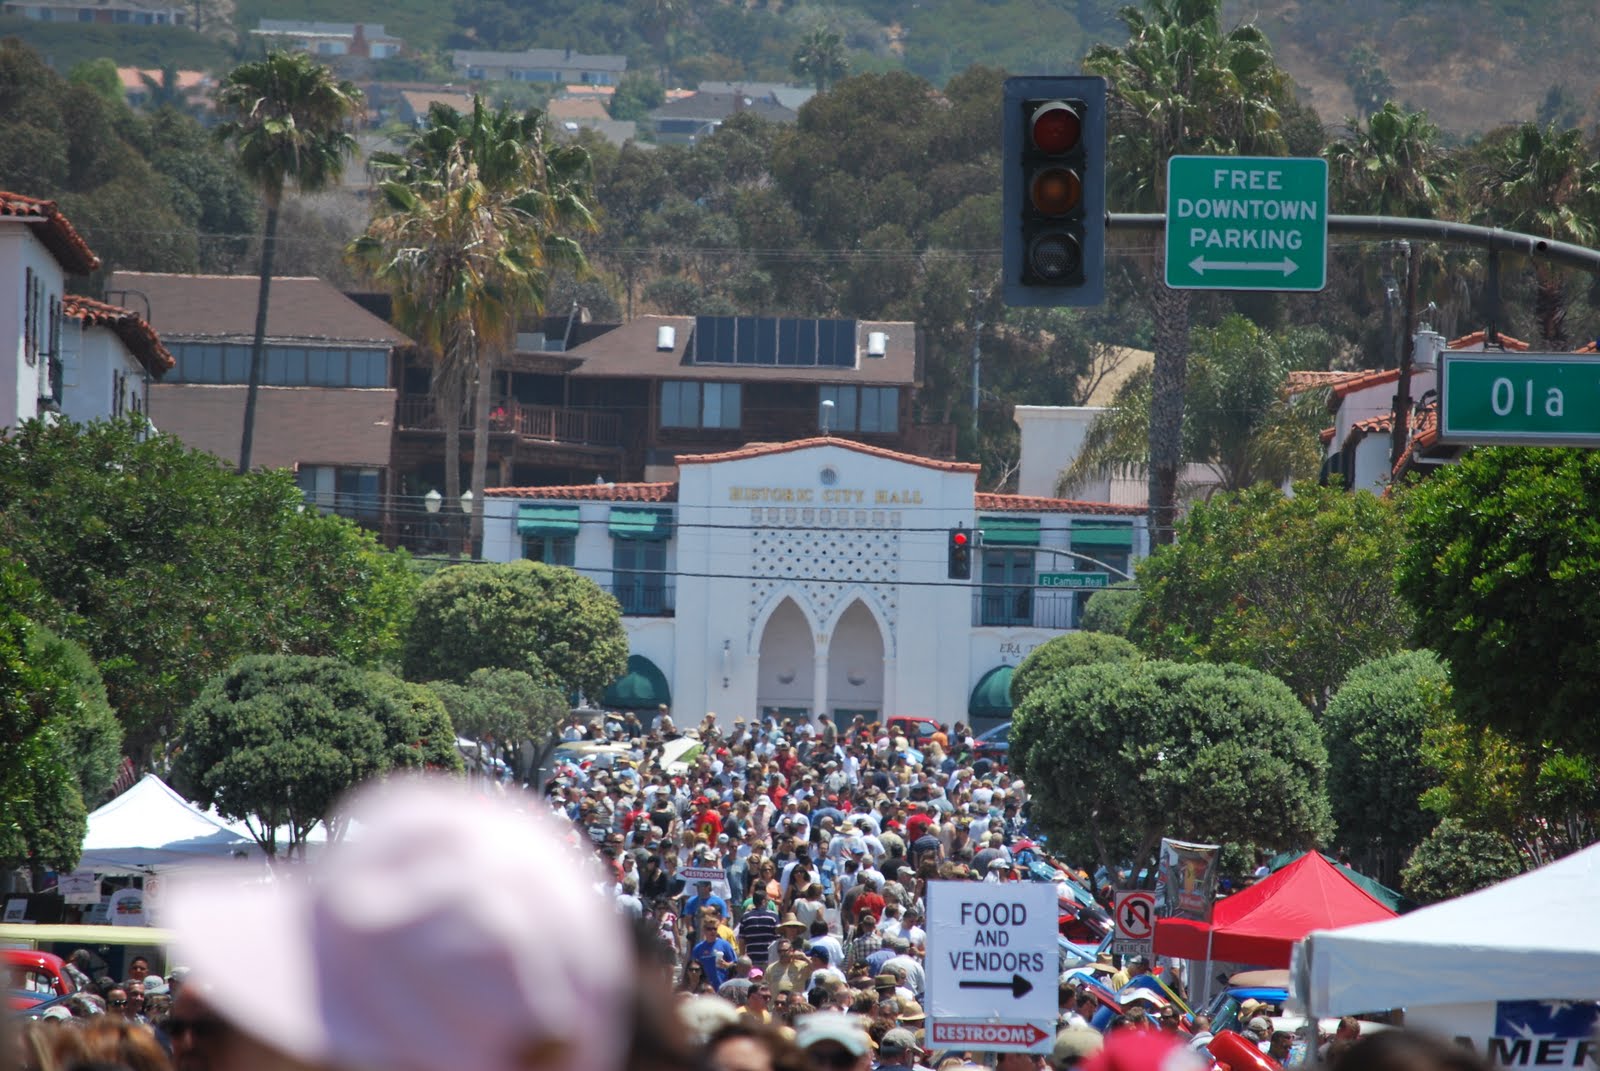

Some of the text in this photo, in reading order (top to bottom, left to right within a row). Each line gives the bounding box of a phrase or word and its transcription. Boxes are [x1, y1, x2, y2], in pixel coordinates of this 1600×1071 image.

[1214, 169, 1283, 190] FREE
[1177, 198, 1317, 220] DOWNTOWN
[1190, 227, 1302, 250] PARKING
[1491, 377, 1564, 417] Ola
[728, 486, 924, 504] HISTORIC CITY HALL
[1043, 576, 1051, 585] El
[1085, 577, 1103, 586] Real
[1000, 643, 1021, 657] ERA
[684, 870, 724, 879] RESTROOMS
[960, 902, 1027, 926] FOOD
[974, 930, 1010, 947] AND
[949, 951, 1044, 972] VENDORS
[935, 1025, 1037, 1043] RESTROOMS
